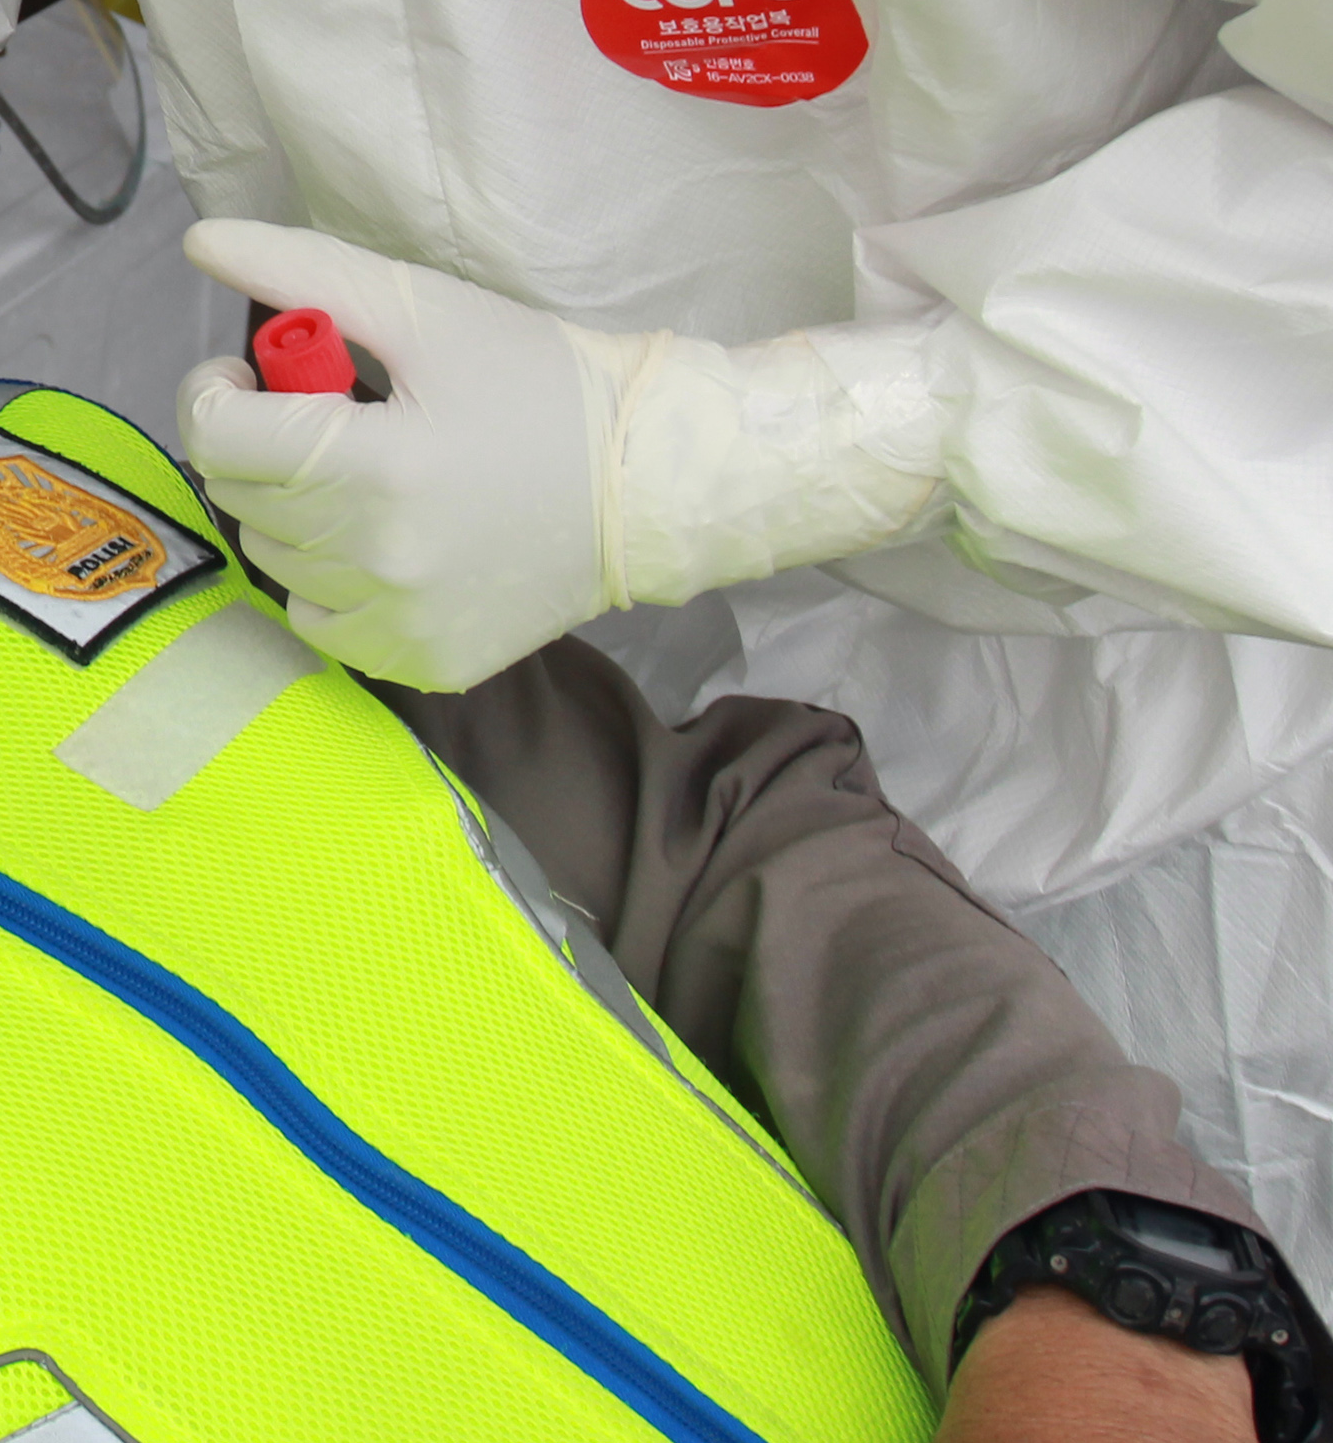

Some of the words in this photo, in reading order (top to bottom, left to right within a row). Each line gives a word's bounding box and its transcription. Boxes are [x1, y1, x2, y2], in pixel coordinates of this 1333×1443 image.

[658, 9, 791, 36] 보호용작업복
[640, 37, 705, 51] Disposable
[708, 31, 768, 46] Protective
[770, 26, 819, 39] Coverall
[67, 536, 137, 580] POLISI
